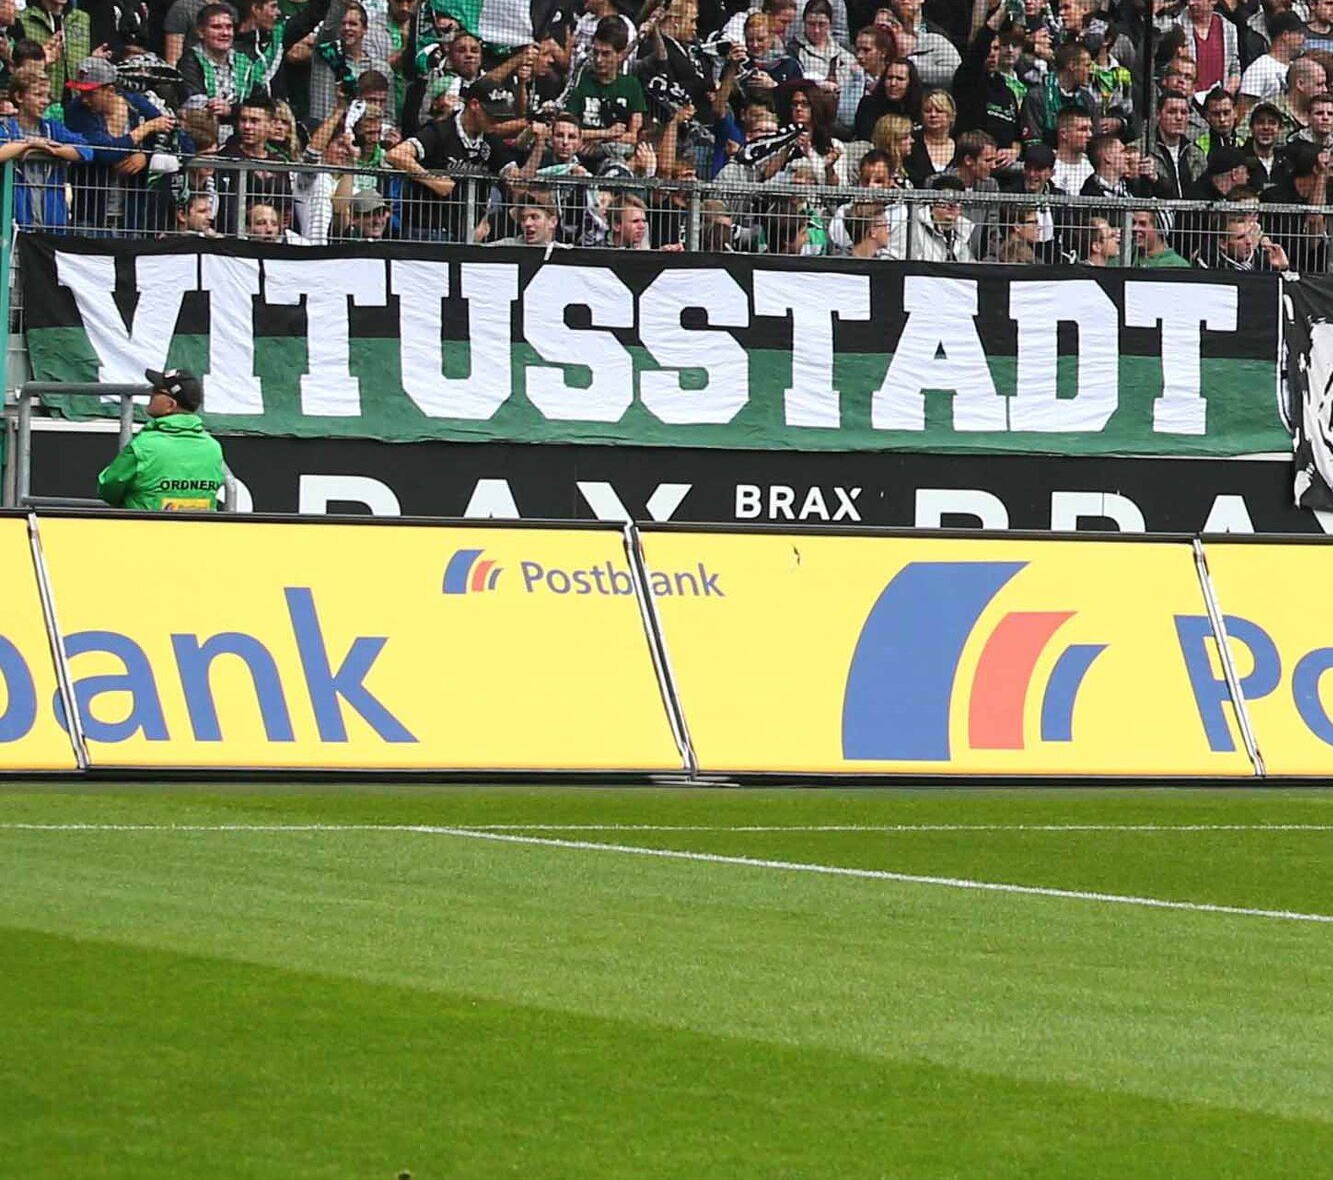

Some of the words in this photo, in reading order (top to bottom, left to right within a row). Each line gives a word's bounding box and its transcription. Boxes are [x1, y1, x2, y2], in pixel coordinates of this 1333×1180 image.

[55, 250, 1239, 437] VITUSSTADT
[735, 484, 863, 523] BRAX
[522, 560, 725, 598] Postbank
